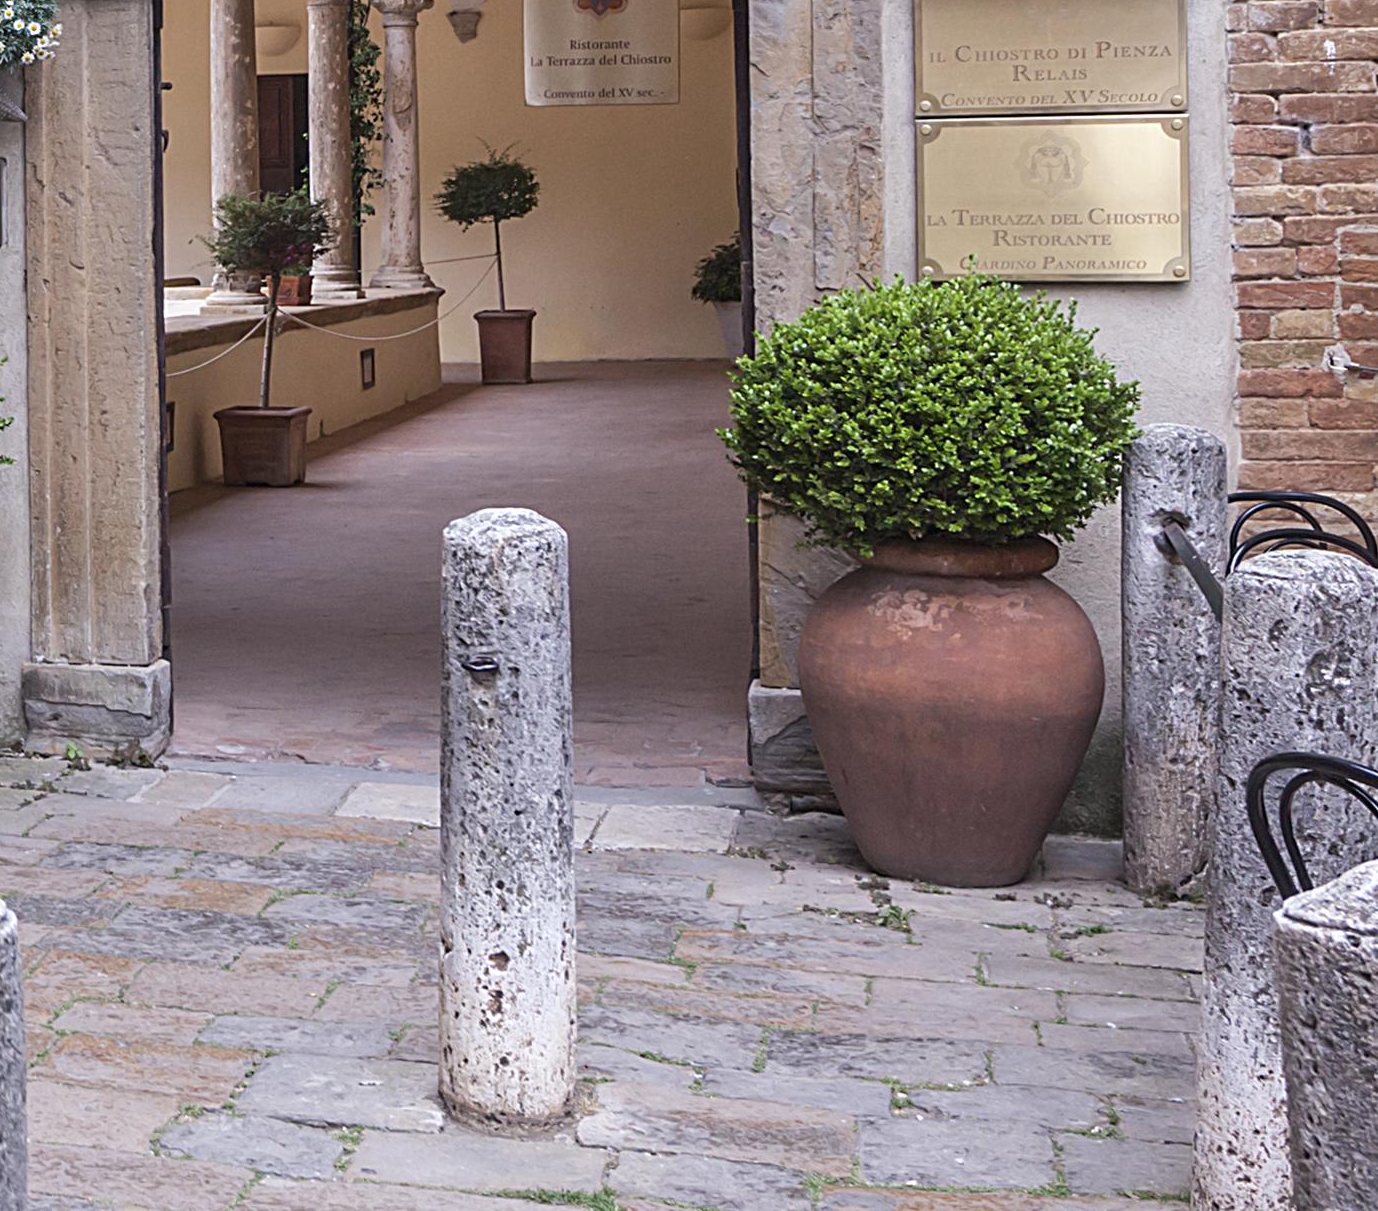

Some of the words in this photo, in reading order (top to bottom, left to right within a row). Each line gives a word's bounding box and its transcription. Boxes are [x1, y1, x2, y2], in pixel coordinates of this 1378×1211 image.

[570, 40, 630, 50] Ristorante
[955, 45, 1058, 63] CHIOSTRO
[1068, 48, 1086, 60] DI
[1095, 41, 1172, 59] PIENZA
[530, 57, 542, 67] La
[547, 56, 595, 66] Terrazza
[599, 55, 617, 65] del
[621, 55, 672, 65] Chiostro
[1012, 65, 1088, 82] RELAIS
[544, 89, 595, 99] Convento
[598, 88, 615, 98] del
[618, 88, 634, 98] XV
[941, 93, 1026, 107] CONVENTO
[1030, 93, 1058, 105] DEL
[1062, 90, 1096, 104] XV
[1098, 89, 1158, 103] SECOLO
[926, 215, 946, 227] LA
[952, 209, 1044, 226] TERRAZZA
[1051, 213, 1083, 225] DEL
[1088, 208, 1180, 225] CHIOSTRO
[992, 230, 1112, 247] RISTORANTE
[1043, 256, 1147, 270] PANORAMICO
